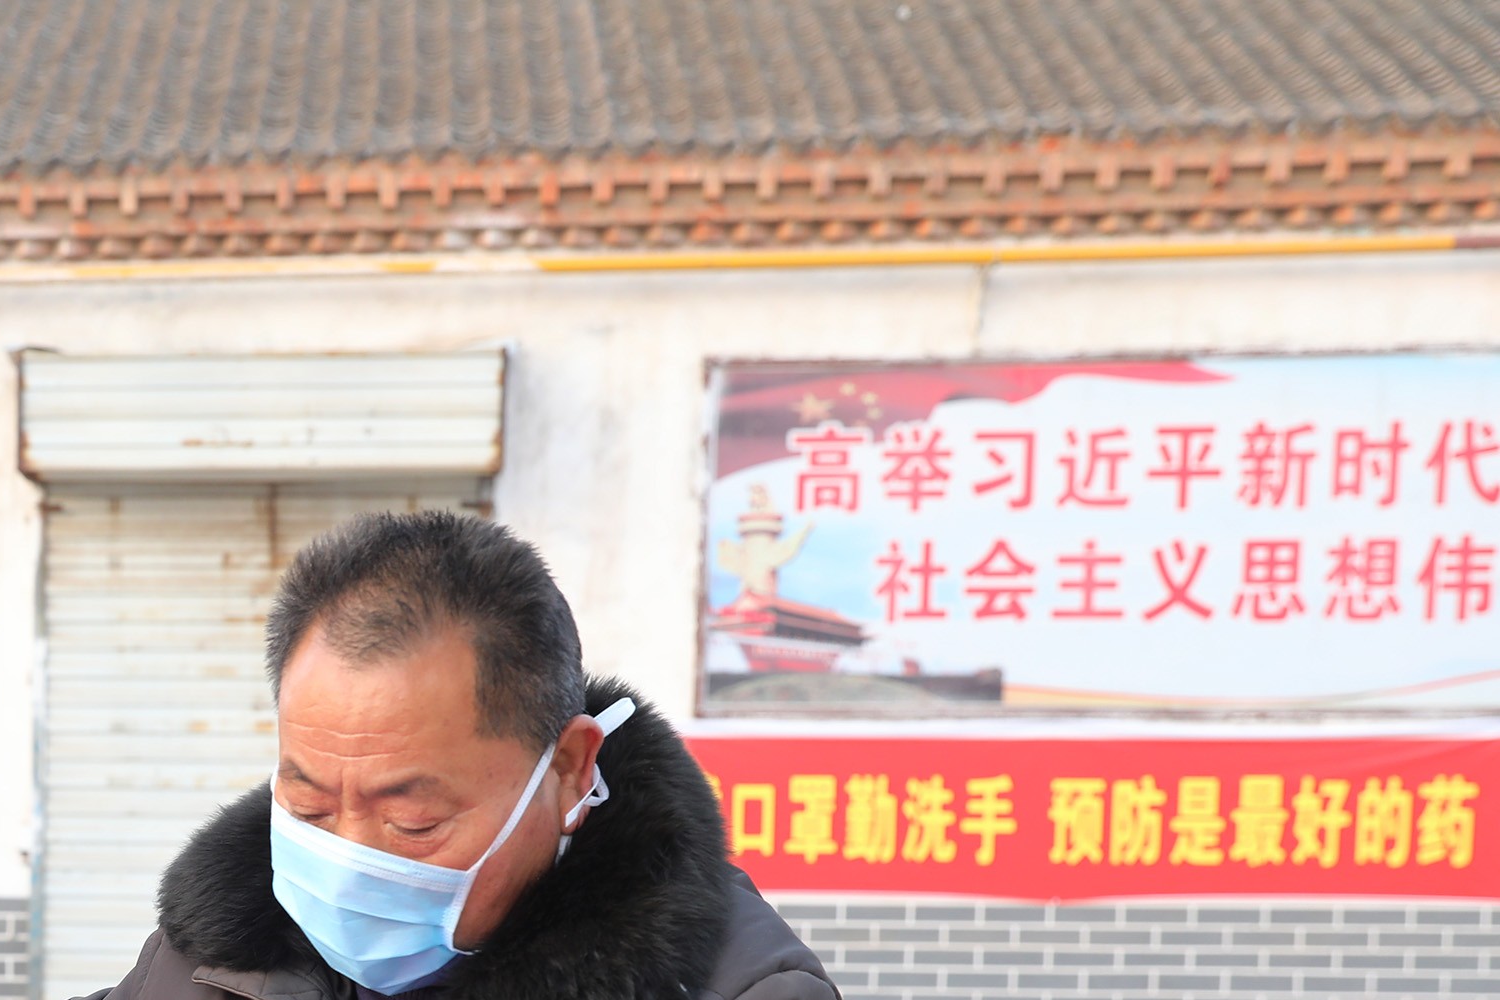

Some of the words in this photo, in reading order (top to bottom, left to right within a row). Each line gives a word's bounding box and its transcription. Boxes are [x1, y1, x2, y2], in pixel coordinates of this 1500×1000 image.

[790, 417, 1500, 512] 高举习近平新时代
[874, 534, 1494, 623] 社会主义思想伟
[704, 773, 1018, 867] 口罩勤洗手
[1047, 774, 1480, 868] 预防是最好的药
